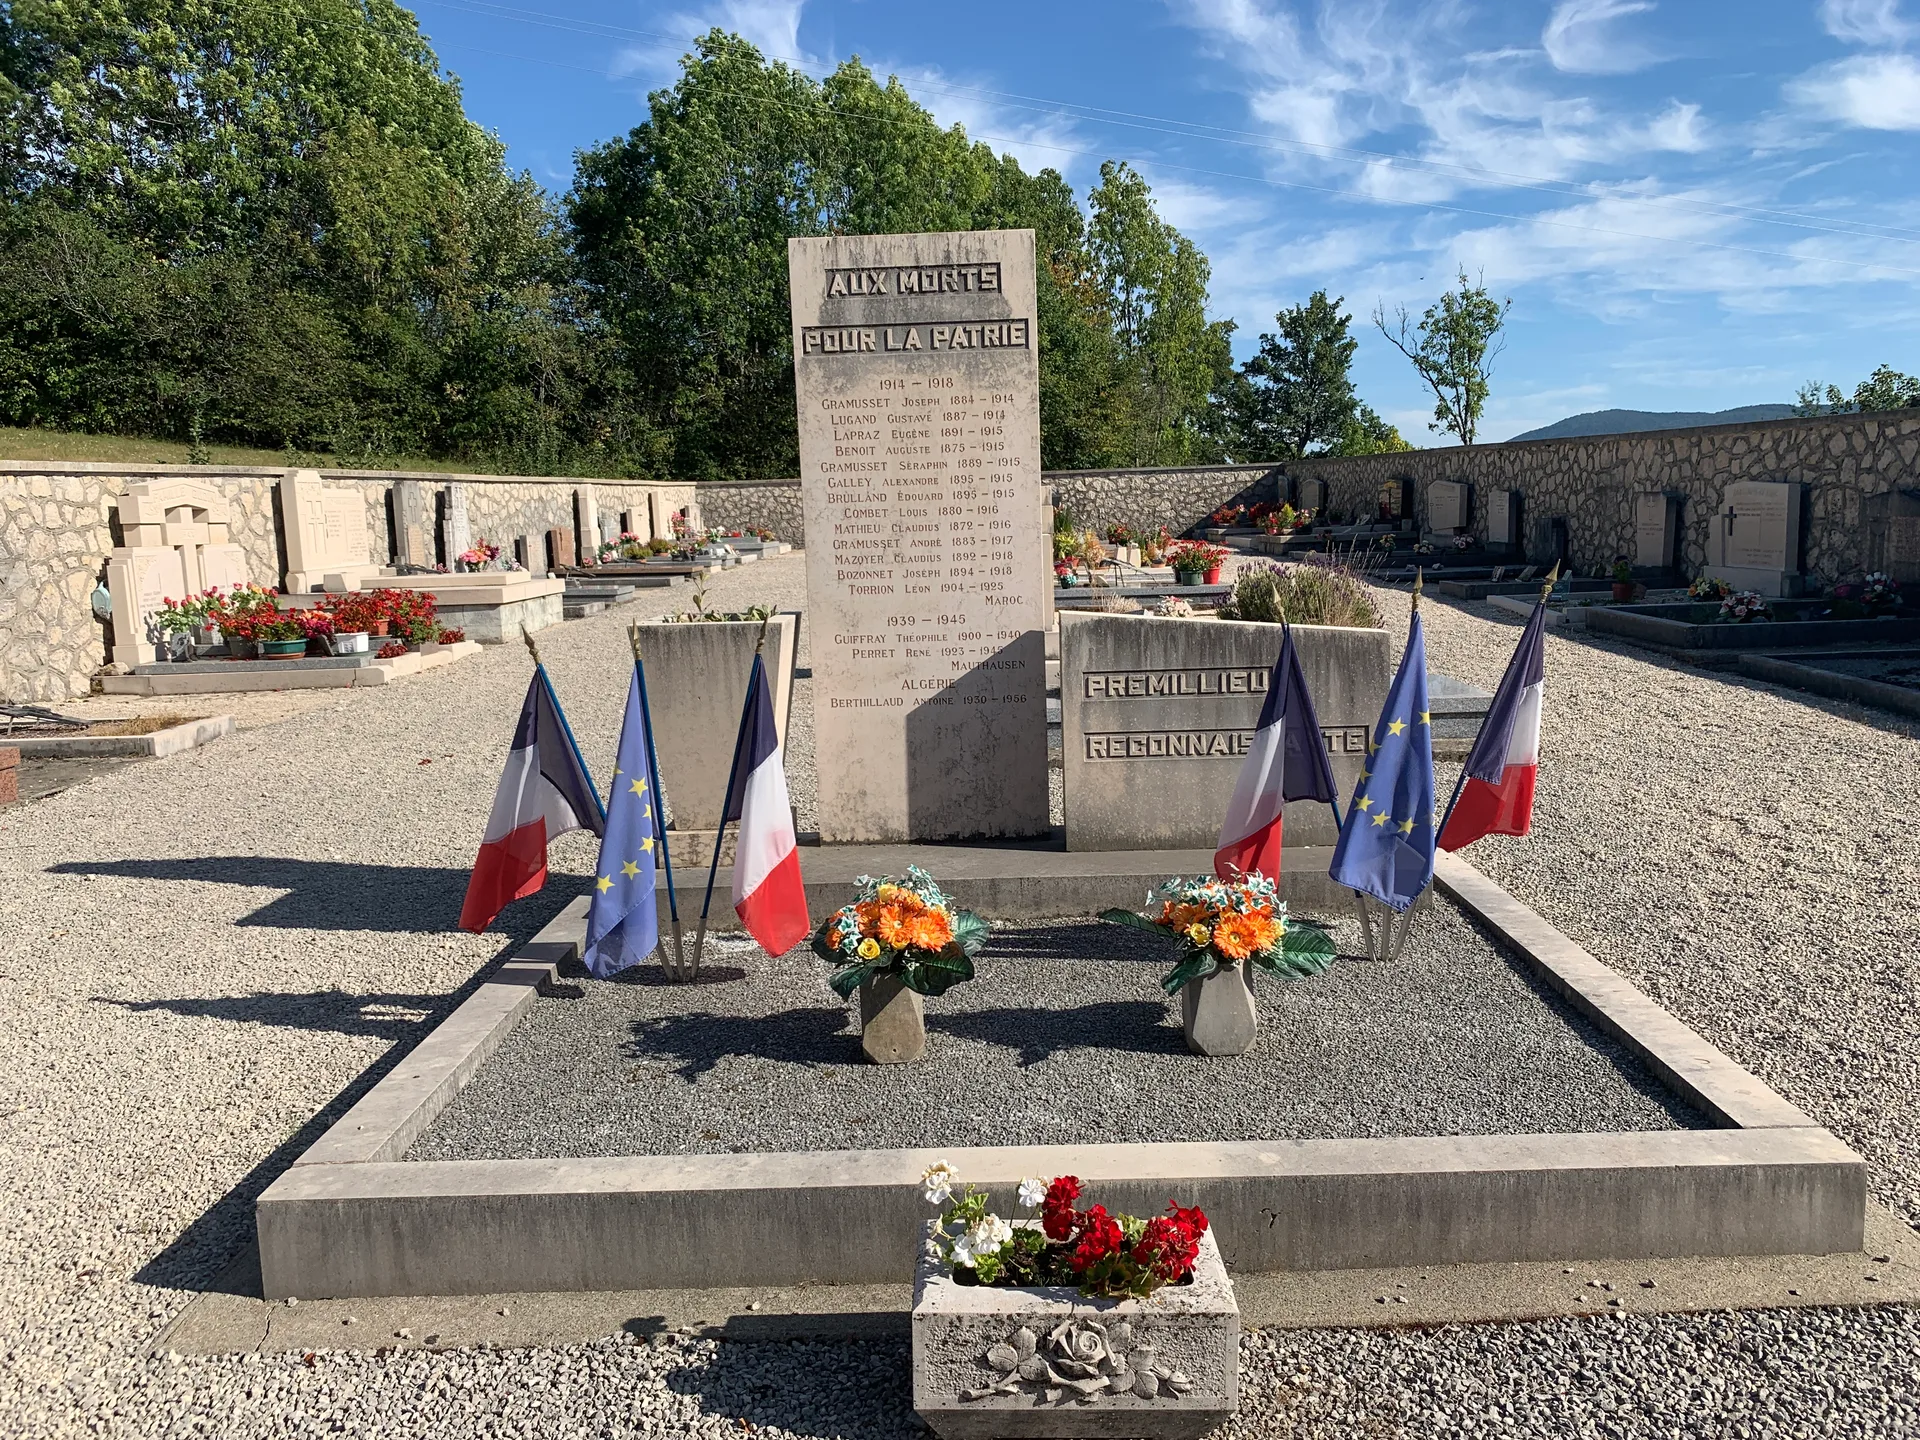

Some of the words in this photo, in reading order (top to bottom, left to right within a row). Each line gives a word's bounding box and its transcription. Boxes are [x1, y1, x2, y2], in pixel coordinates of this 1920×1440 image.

[830, 271, 887, 296] AUX
[898, 268, 998, 293] MORTS
[805, 327, 876, 353] POUR
[885, 328, 922, 350] LA
[932, 324, 1025, 348] PATRIE
[880, 379, 905, 390] 1914
[928, 378, 953, 388] 1918
[822, 398, 890, 410] GRAMUSSET
[902, 397, 940, 407] JOSEPH
[950, 395, 974, 405] 1884
[992, 394, 1014, 403] 1914
[831, 414, 876, 425] LUGAND
[943, 412, 967, 421] 1887
[983, 410, 1005, 420] 1914
[834, 430, 879, 441] LAPRAZ
[892, 428, 930, 439] EUGÈNE
[941, 427, 963, 437] 1891
[981, 426, 1003, 435] 1915
[836, 446, 875, 456] BENOIT
[886, 445, 930, 455] AUGUSTE
[941, 443, 965, 453] 1875
[982, 442, 1004, 451] 1915
[821, 462, 887, 473] GRAMUSSET
[900, 459, 948, 471] SÉRAPHIN
[958, 459, 982, 468] 1889
[998, 457, 1020, 467] 1915
[828, 478, 872, 488] GALLEY
[882, 477, 939, 487] ALEXANDRE
[950, 474, 974, 484] 1895
[990, 473, 1012, 483] 1915
[953, 490, 977, 500] 1895
[993, 489, 1014, 498] 1915
[844, 509, 888, 519] COMBET
[900, 508, 927, 517] LOUIS
[938, 506, 962, 515] 1880
[978, 505, 998, 514] 1916
[835, 524, 880, 534] MATHIEU
[892, 523, 939, 533] CLAUDIUS
[950, 522, 973, 531] 1872
[989, 520, 1011, 529] 1916
[833, 539, 899, 550] GRAMUSSET
[910, 537, 942, 548] ANDRÉ
[953, 537, 975, 546] 1883
[992, 535, 1013, 545] 1917
[835, 554, 884, 565] MAZOYER
[894, 553, 941, 563] CLAUDIUS
[953, 552, 976, 561] 1892
[992, 551, 1013, 560] 1918
[838, 570, 893, 580] BOZONNET
[950, 567, 974, 577] 1894
[990, 566, 1012, 576] 1918
[849, 585, 894, 595] TORRION
[905, 584, 931, 593] LÉON
[941, 583, 964, 592] 1904
[981, 582, 1003, 591] 1925
[985, 595, 1023, 605] MAROC
[887, 616, 915, 627] 1939
[937, 614, 966, 625] 1945
[835, 634, 886, 644] GUIFFRAY
[896, 632, 947, 643] THÉOPHILE
[958, 631, 981, 641] 1900
[997, 630, 1020, 640] 1940
[852, 649, 895, 659] PERRET
[906, 647, 931, 657] RENÉ
[941, 647, 964, 656] 1923
[980, 646, 1003, 655] 1945
[951, 660, 1025, 671] MAUTHAUSEN
[902, 675, 955, 690] ALGÉRIE
[1087, 671, 1269, 697] PREMILLIEU
[831, 697, 903, 708] BERTHILLAUD
[913, 697, 953, 706] ANTOINE
[963, 695, 986, 704] 1930
[1003, 694, 1026, 703] 1956
